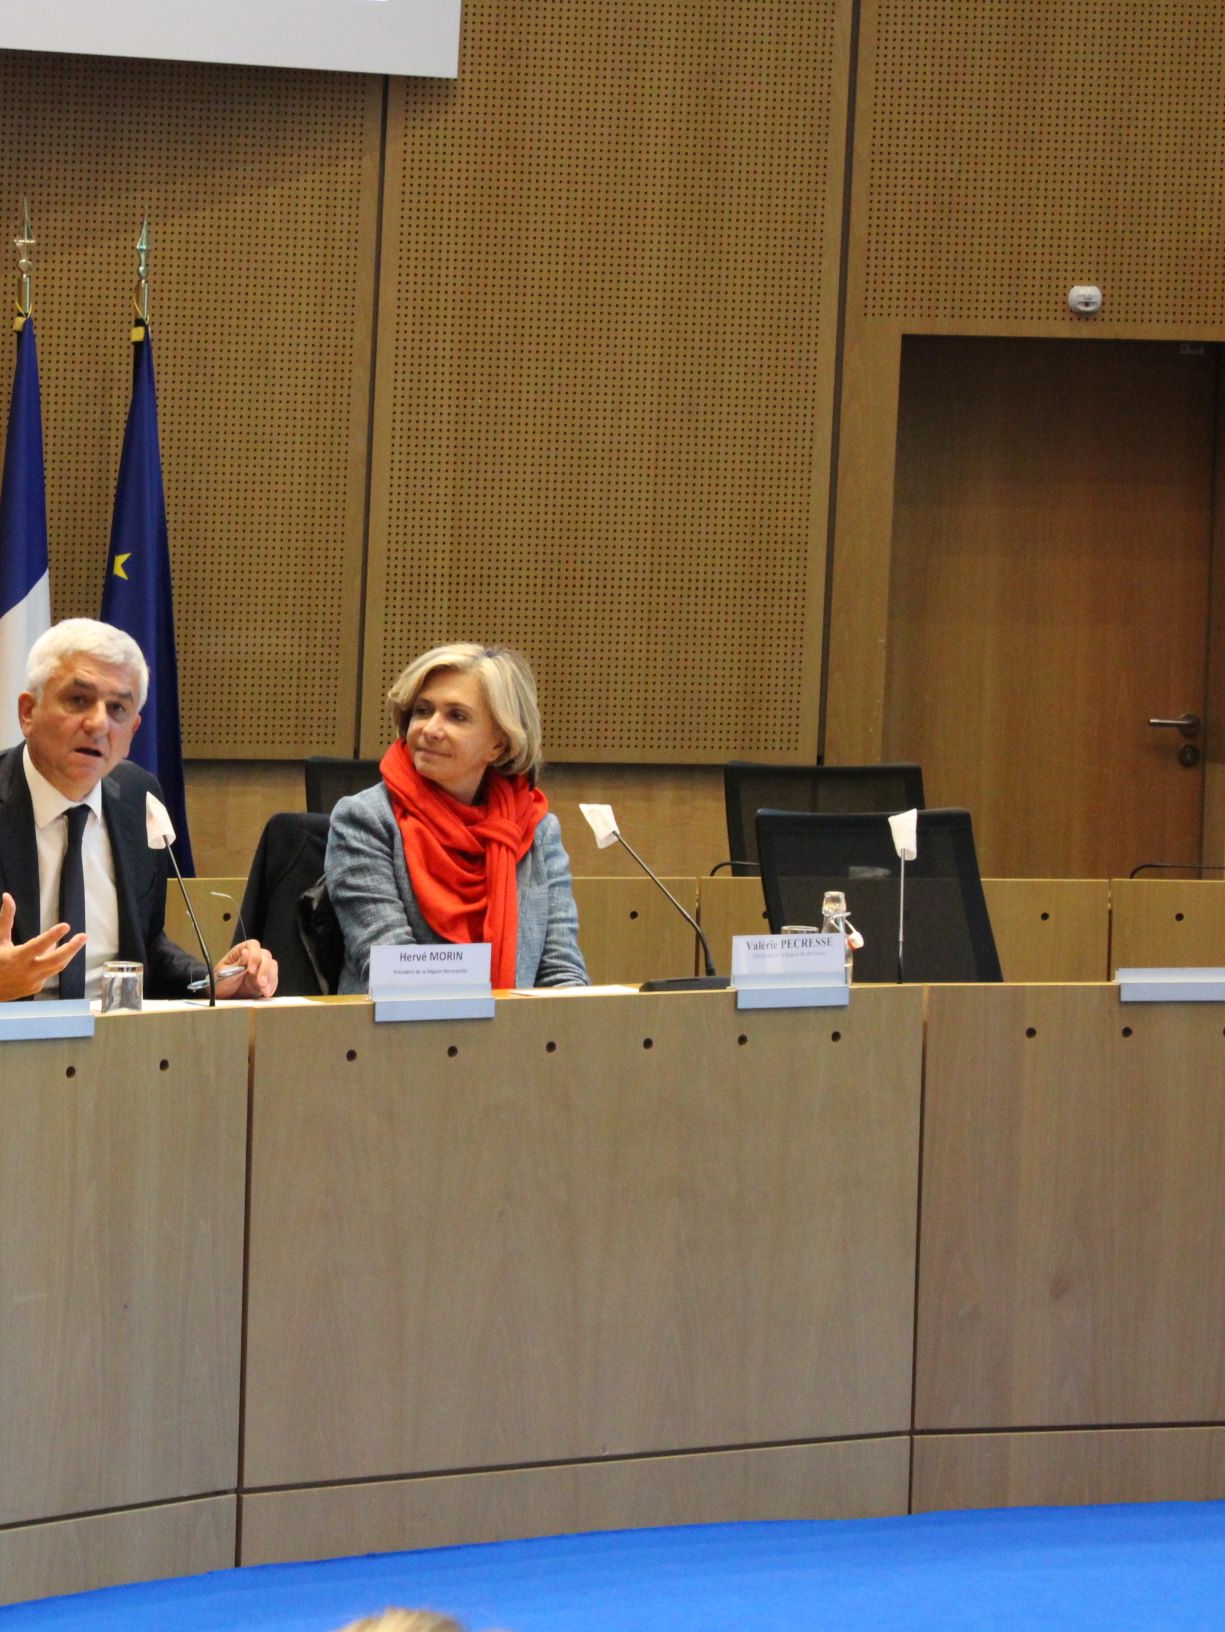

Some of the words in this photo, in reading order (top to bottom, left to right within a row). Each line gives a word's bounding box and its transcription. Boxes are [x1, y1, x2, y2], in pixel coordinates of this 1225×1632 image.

[746, 940, 778, 951] Valérie
[400, 951, 427, 962] Hervé
[429, 951, 463, 961] MORIN
